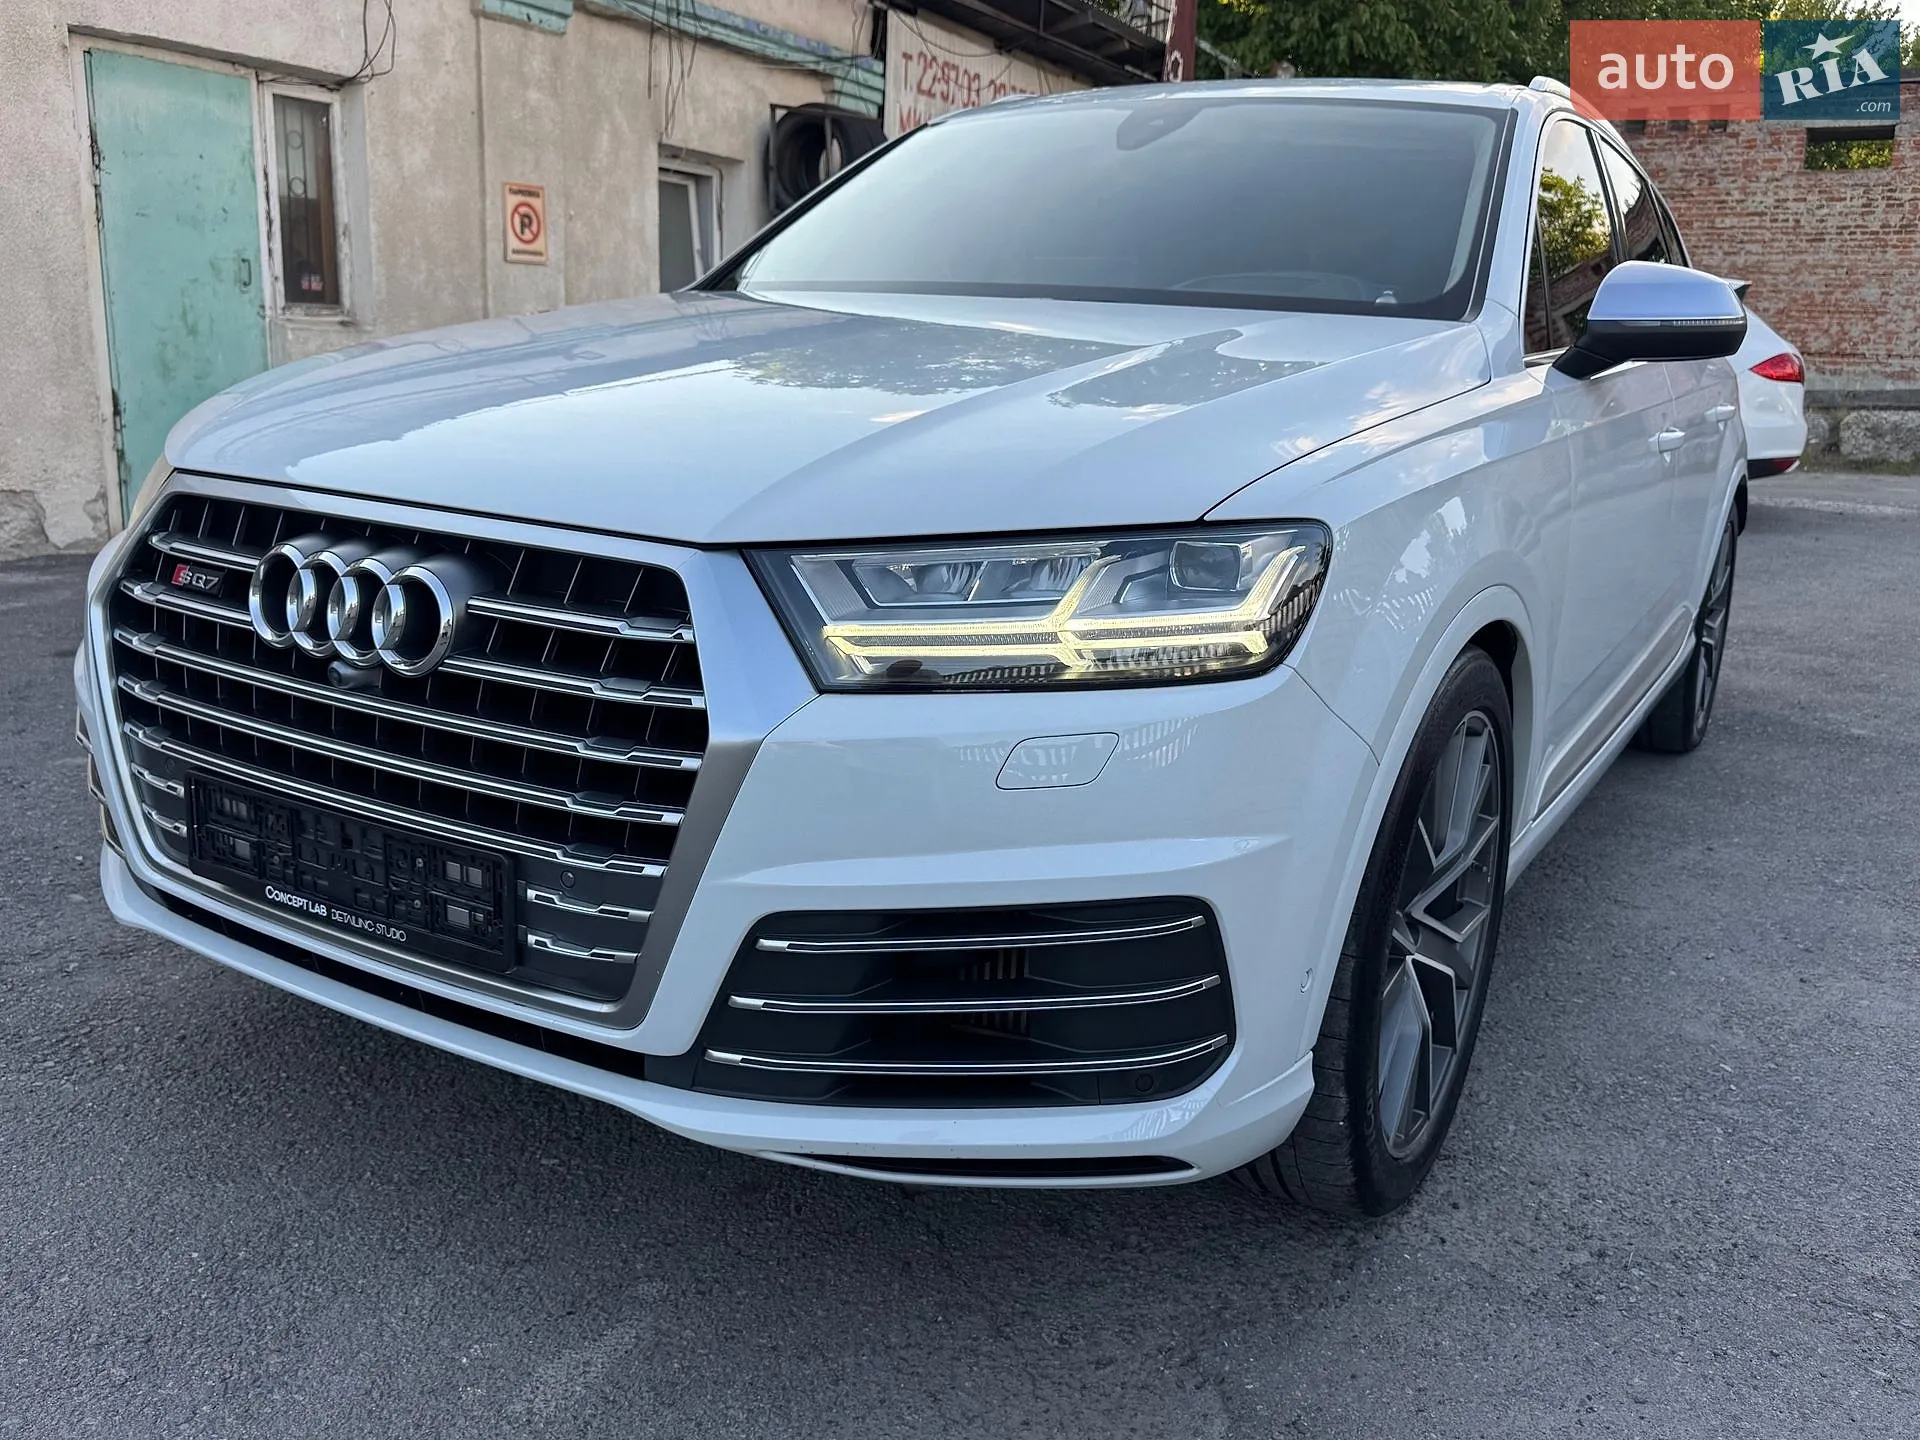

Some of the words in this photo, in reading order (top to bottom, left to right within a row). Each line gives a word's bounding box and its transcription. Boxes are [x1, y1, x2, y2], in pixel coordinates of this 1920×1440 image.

[177, 567, 219, 590] SQ7
[265, 885, 309, 911] CONCEPT
[309, 900, 328, 917] LAB
[376, 923, 407, 942] STUDIO
